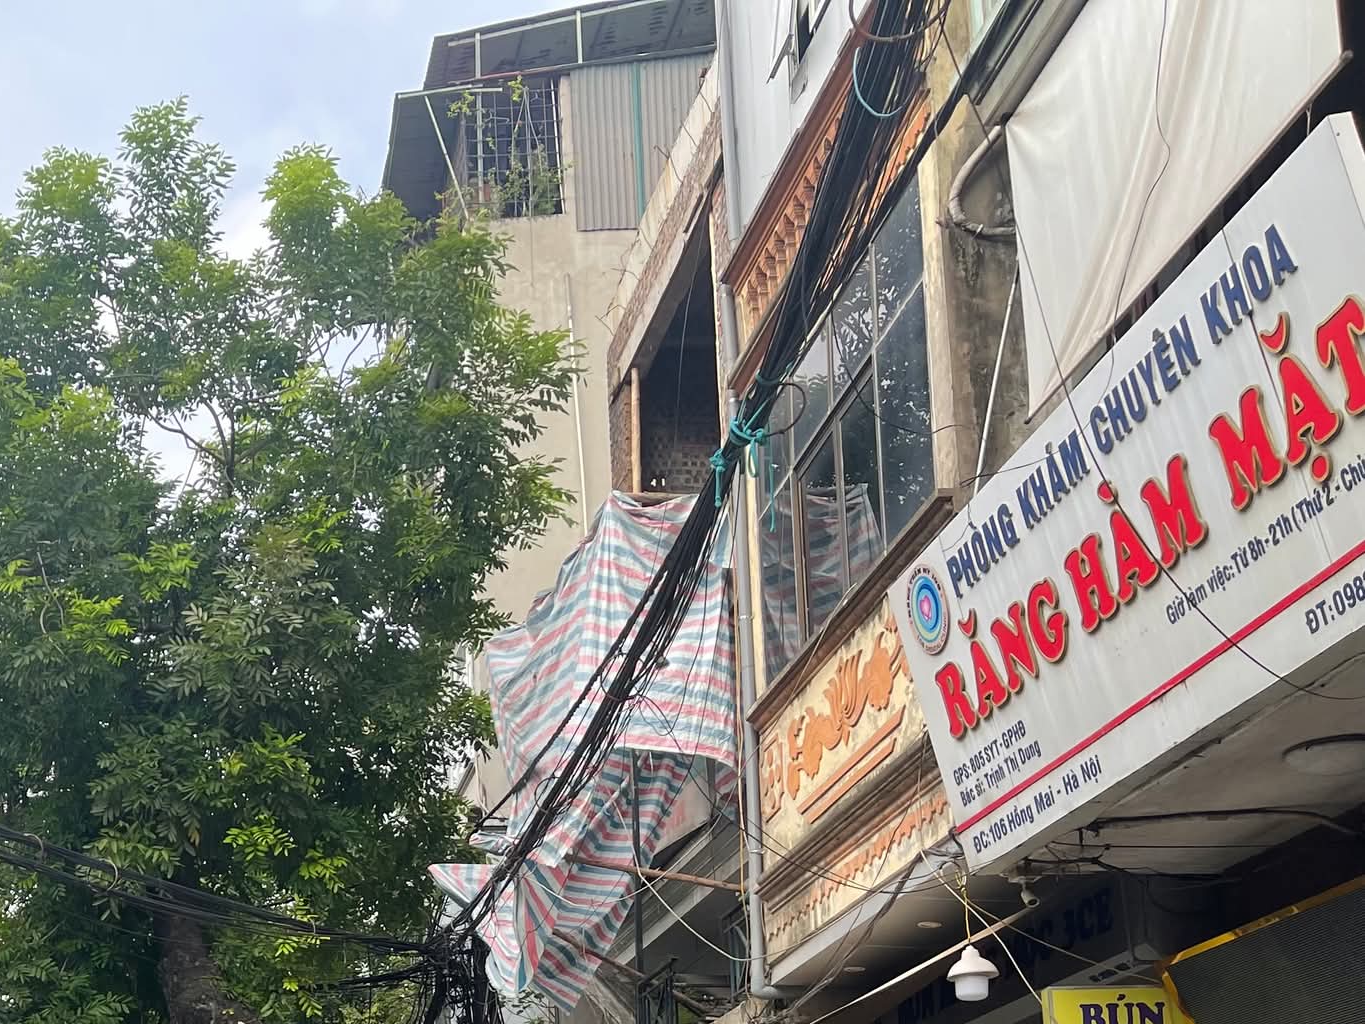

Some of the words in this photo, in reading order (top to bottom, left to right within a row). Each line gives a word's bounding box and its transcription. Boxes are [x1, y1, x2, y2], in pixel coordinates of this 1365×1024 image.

[946, 503, 1020, 600] PHÒNG
[1016, 429, 1090, 529] KHÁM
[1090, 314, 1202, 455] CHUYÊN
[1200, 223, 1298, 345] KHOA
[935, 576, 1068, 740] RĂNG
[1064, 453, 1209, 633] HÀM
[1208, 294, 1365, 511] MẶT
[1333, 571, 1365, 616] 098
[1019, 740, 1041, 765] Dung
[1007, 804, 1034, 833] Hồng
[1034, 785, 1056, 814] Mai
[1062, 769, 1080, 795] Hà
[1080, 754, 1102, 783] Nội
